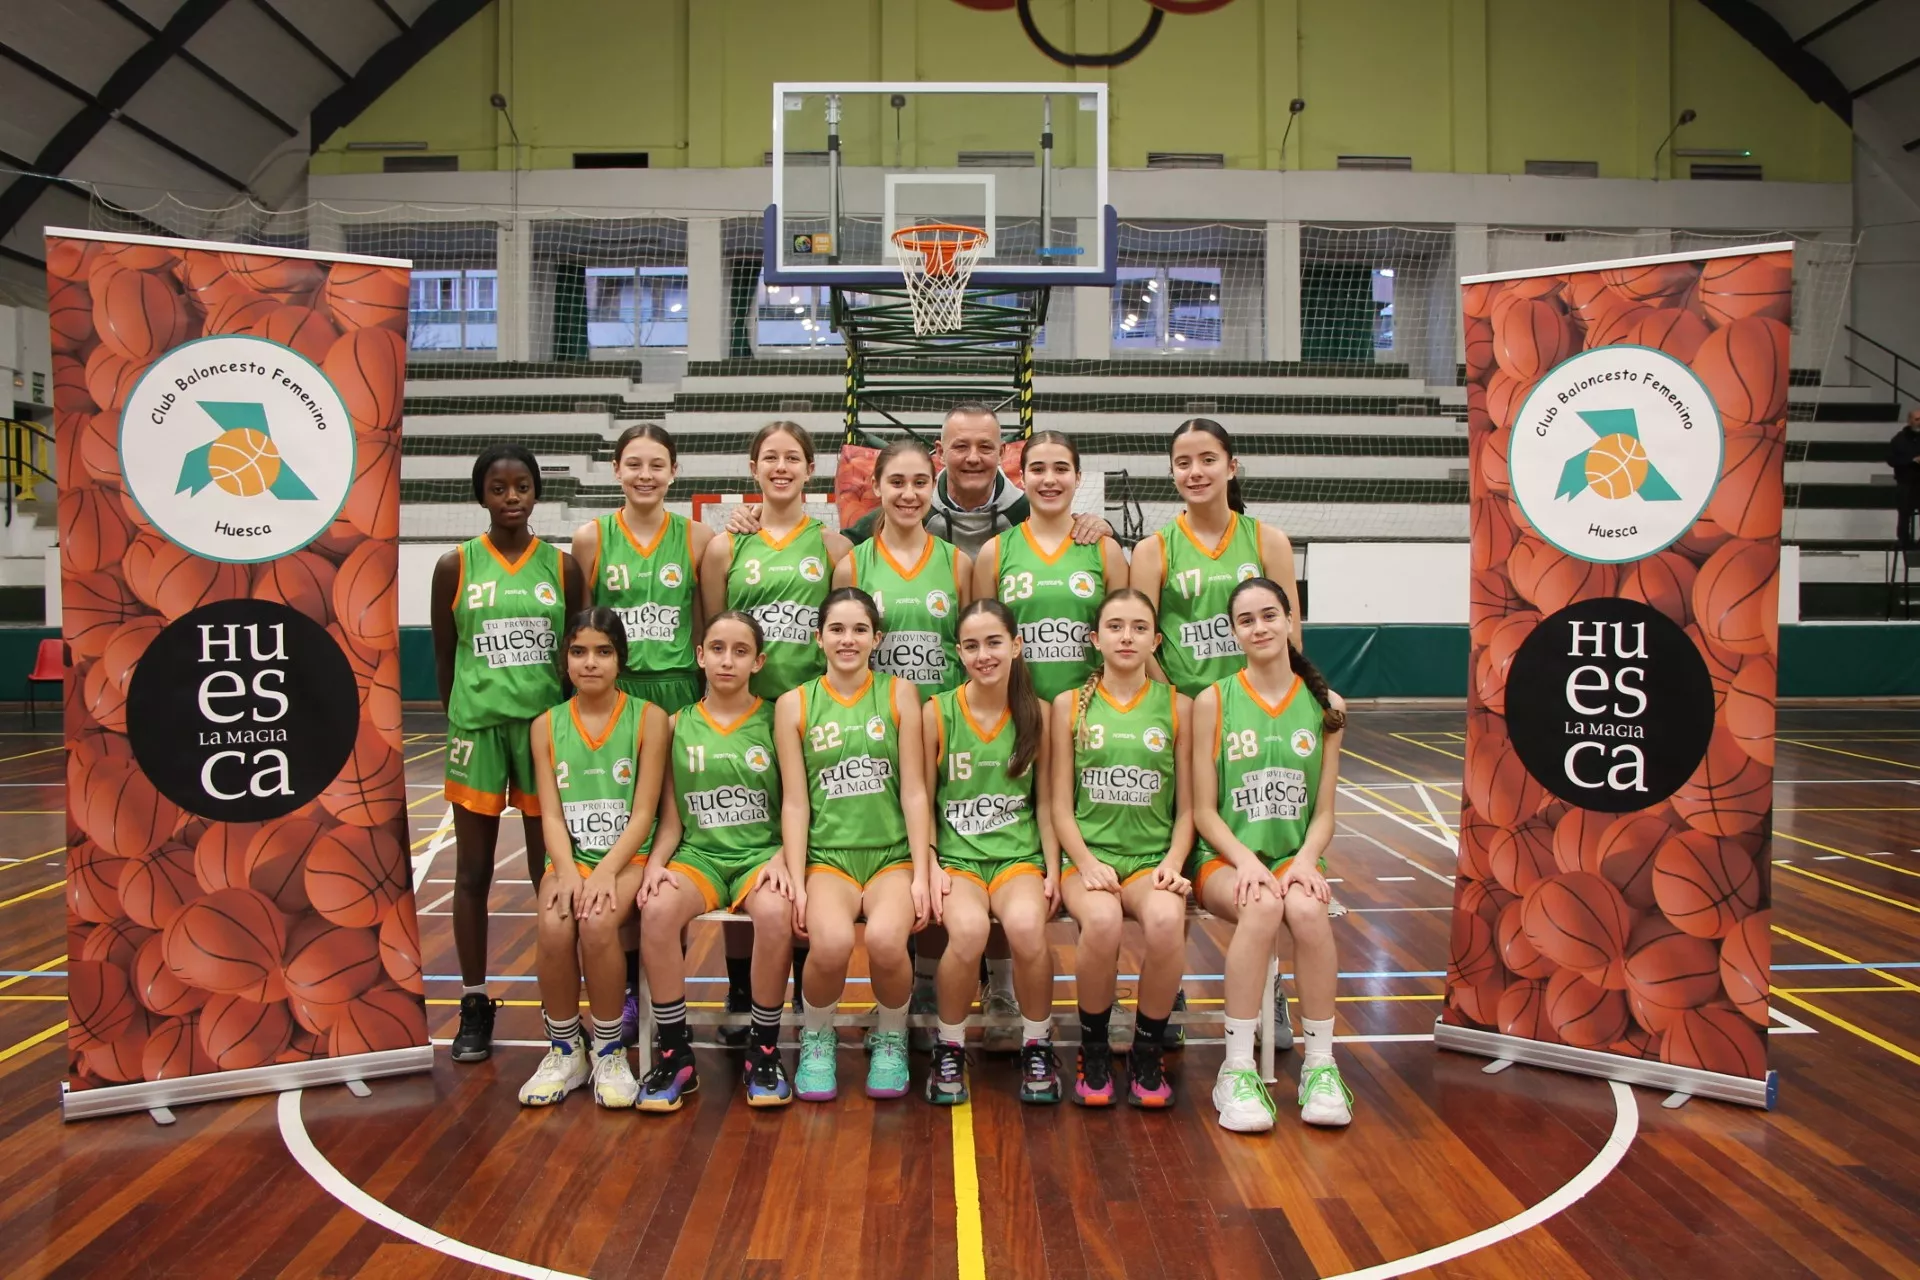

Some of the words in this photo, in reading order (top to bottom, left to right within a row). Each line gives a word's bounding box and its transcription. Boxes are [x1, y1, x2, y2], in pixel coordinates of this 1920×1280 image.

[151, 392, 176, 425] Club
[175, 361, 266, 391] Baloncesto
[271, 368, 327, 431] Femenino
[1536, 405, 1557, 437] Club
[1557, 369, 1638, 404] Baloncesto
[1643, 372, 1693, 430] Femenino
[214, 520, 272, 537] Huesca
[1588, 522, 1638, 538] Huesca
[606, 564, 630, 591] 21
[744, 559, 761, 585] 3
[1176, 568, 1200, 599] 17
[467, 580, 497, 609] 27
[1003, 571, 1033, 604] 23
[618, 605, 680, 626] uesca
[750, 603, 820, 628] esca
[197, 622, 289, 662] Hu
[475, 629, 556, 653] Huesca
[1019, 621, 1091, 644] uesca
[1567, 620, 1649, 659] Hu
[198, 669, 289, 723] es
[1565, 665, 1647, 718] es
[810, 721, 843, 752] 22
[1227, 729, 1258, 761] 28
[450, 737, 474, 766] 27
[686, 745, 705, 773] 11
[949, 751, 972, 780] 15
[200, 748, 295, 800] ca
[1083, 767, 1159, 790] Huesca
[1564, 741, 1649, 793] ca
[688, 787, 766, 811] Huesca
[1235, 781, 1307, 808] Huesca
[569, 812, 631, 834] uesca
